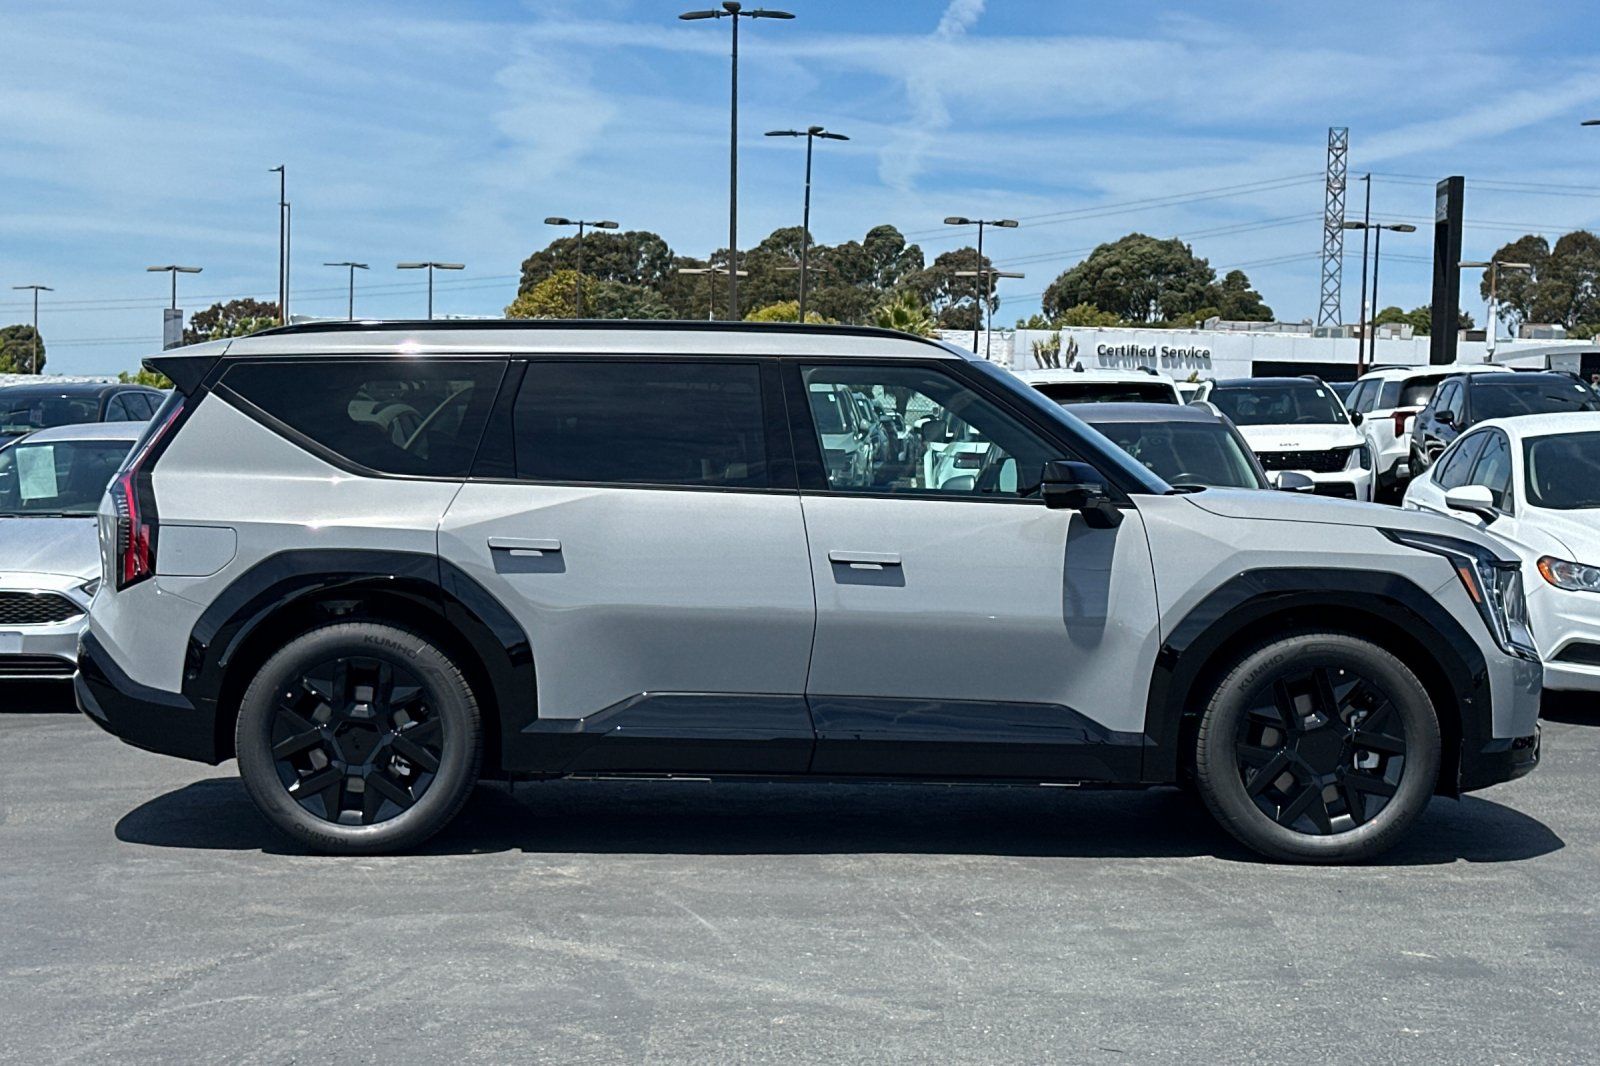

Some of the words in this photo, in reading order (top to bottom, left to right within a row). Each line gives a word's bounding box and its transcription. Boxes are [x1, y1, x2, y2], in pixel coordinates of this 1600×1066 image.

[1097, 344, 1157, 357] Certified
[1161, 346, 1211, 359] Service
[364, 634, 418, 660] KUMHO
[1237, 654, 1284, 692] KUMHO
